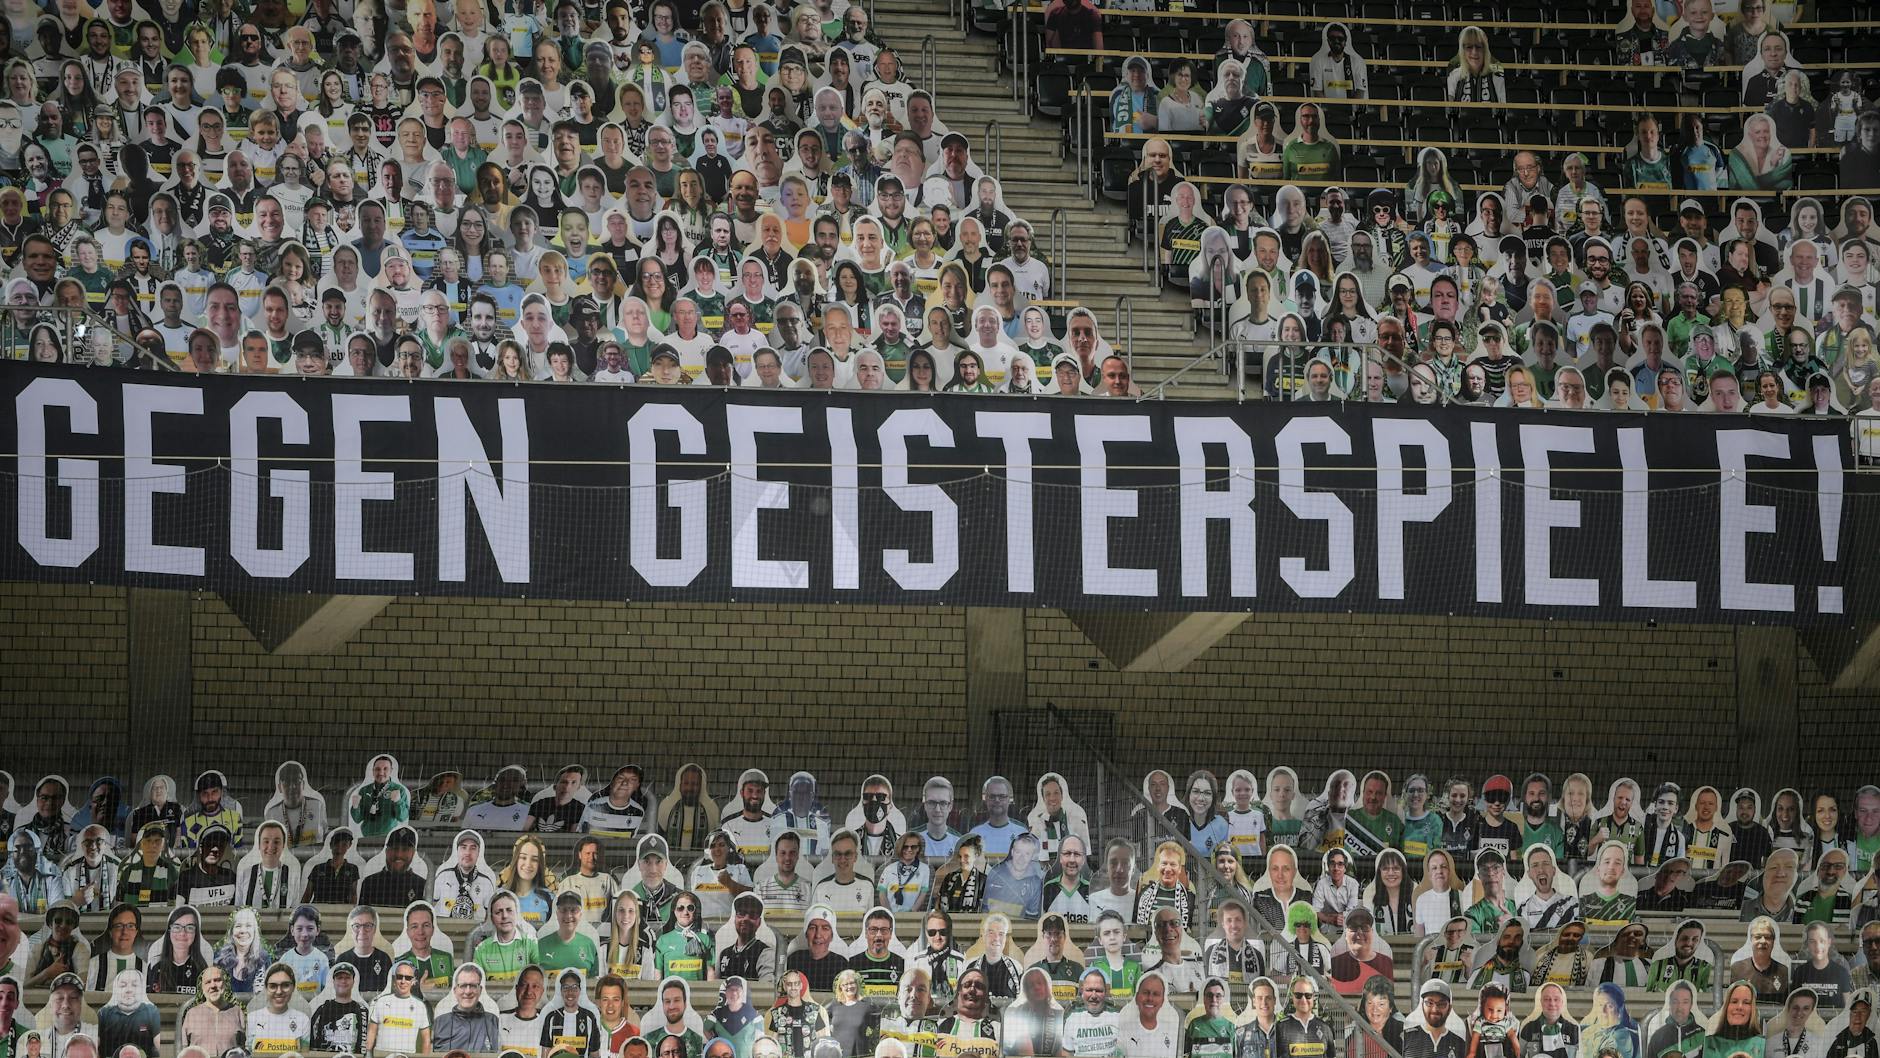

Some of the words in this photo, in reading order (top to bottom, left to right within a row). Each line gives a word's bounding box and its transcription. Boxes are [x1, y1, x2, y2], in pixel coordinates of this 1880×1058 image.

[16, 377, 530, 583] GEGEN
[628, 402, 1845, 614] GEISTERSPIELE!
[1076, 1026, 1114, 1039] ANTONIA
